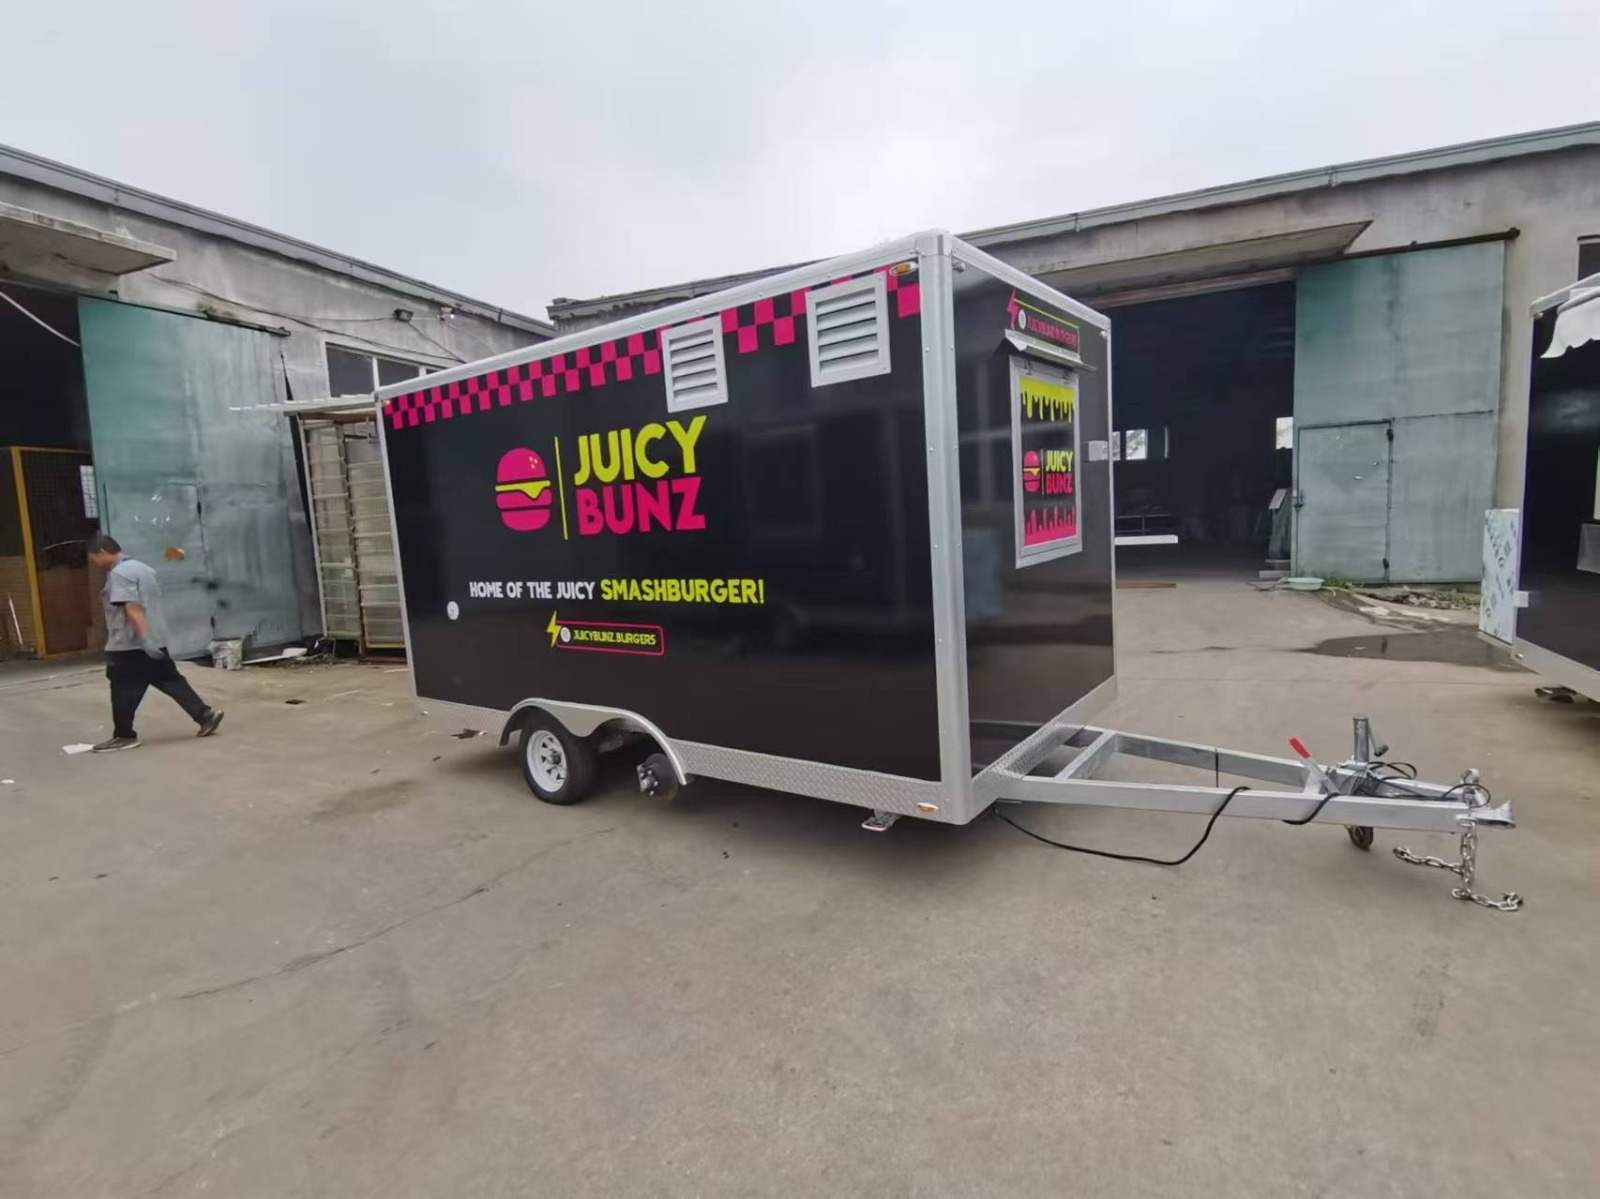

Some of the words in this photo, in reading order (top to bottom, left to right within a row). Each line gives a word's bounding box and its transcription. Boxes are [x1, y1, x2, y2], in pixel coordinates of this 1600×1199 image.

[574, 415, 707, 486] JUICY
[1045, 450, 1073, 472] JUICY
[576, 476, 706, 536] BUNZ
[469, 581, 504, 598] HOME
[506, 582, 523, 598] OF
[527, 582, 553, 599] THE
[556, 582, 595, 600] JUICY
[600, 579, 765, 604] SMASHBURGER!
[573, 629, 656, 646] JUICYBUNZ.BURGERS
